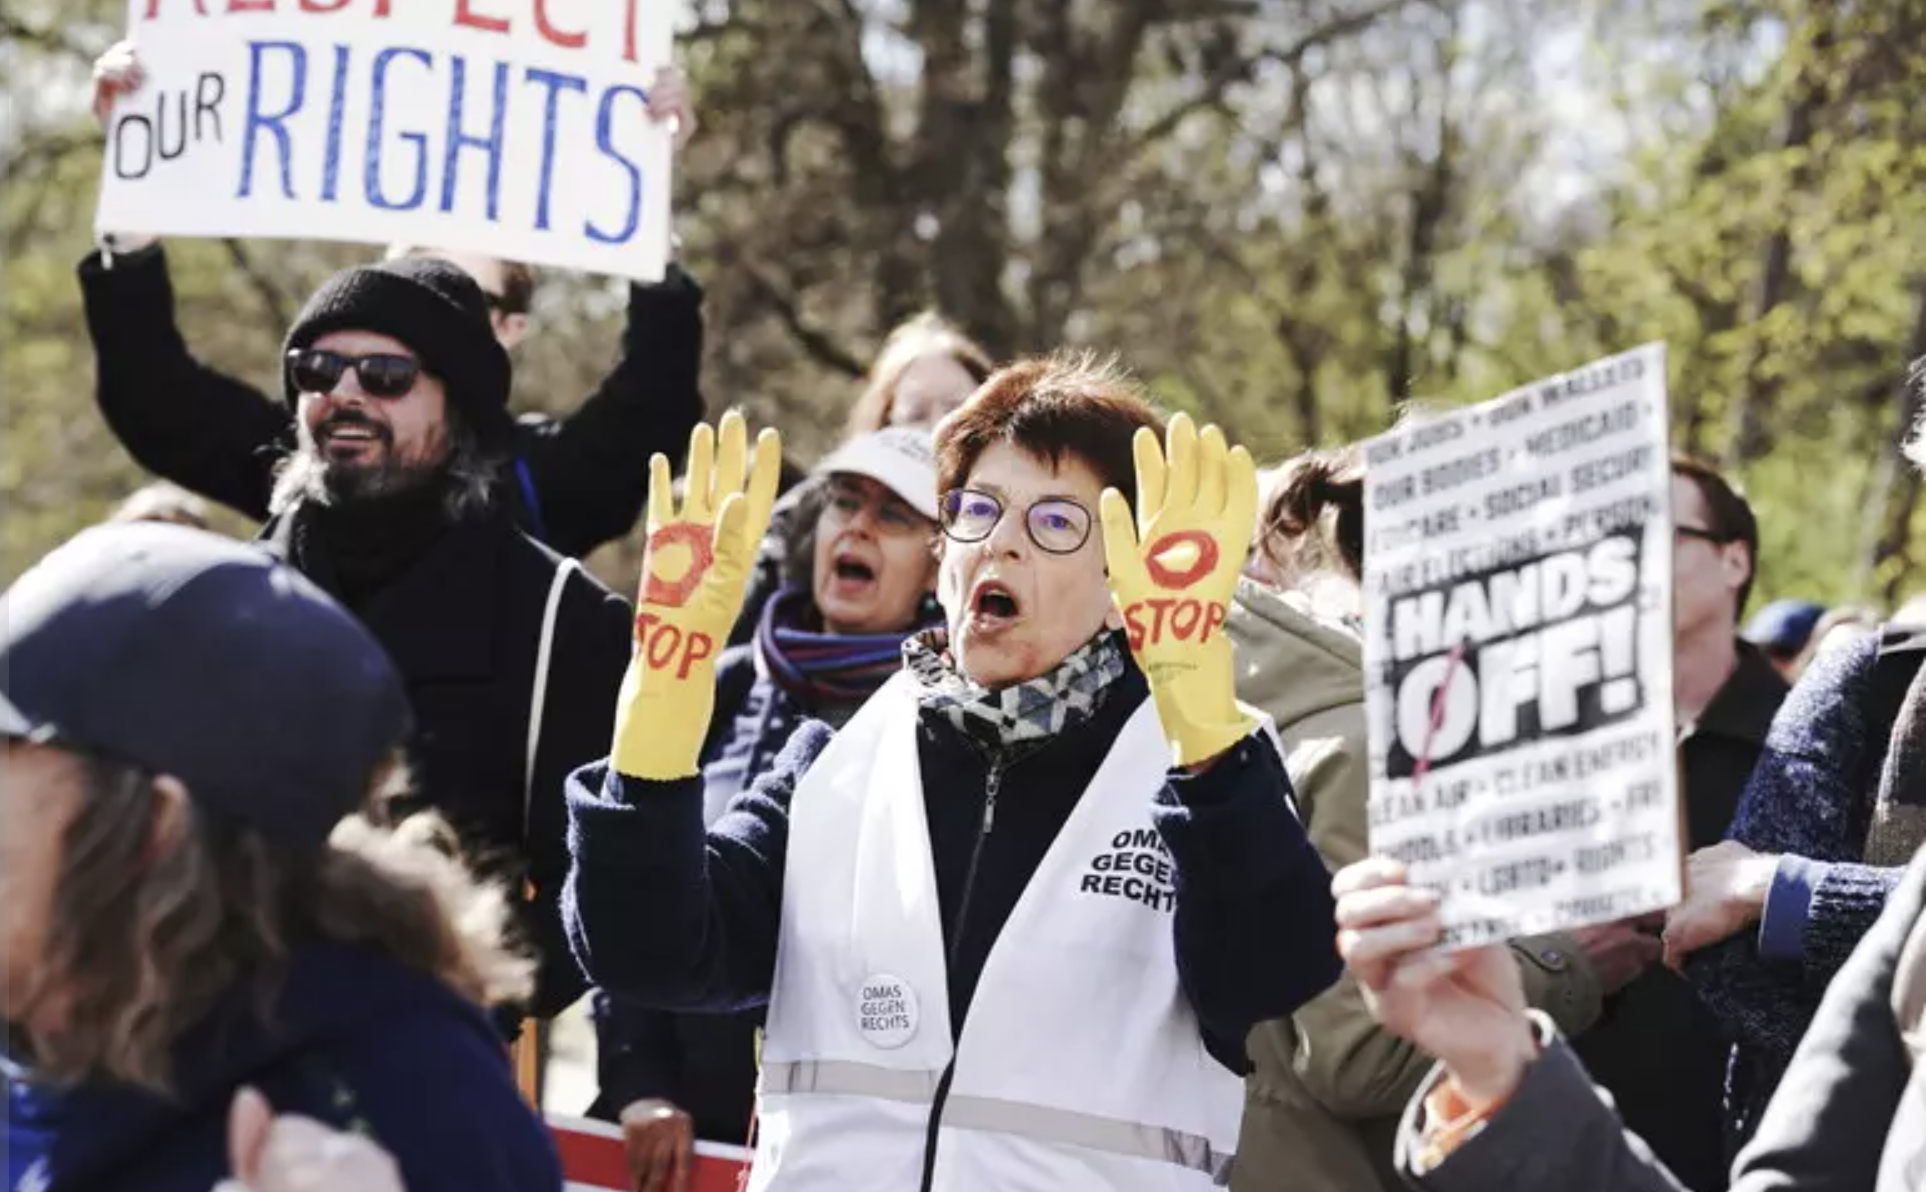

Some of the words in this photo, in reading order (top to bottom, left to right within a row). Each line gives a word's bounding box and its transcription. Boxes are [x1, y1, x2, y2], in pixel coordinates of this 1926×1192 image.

[114, 71, 226, 180] OUR
[235, 40, 651, 246] RIGHTS
[1373, 474, 1415, 511] OUR
[1421, 448, 1500, 494] BODIES
[1524, 399, 1638, 455] MEDICAID
[1485, 474, 1563, 521] SOCIAL
[1391, 534, 1638, 663] HANDS
[636, 612, 712, 680] TOP
[1123, 598, 1226, 652] STOP
[1397, 602, 1638, 762] OFF!
[1080, 874, 1176, 913] RECHT
[1091, 852, 1172, 885] GEGE
[860, 999, 905, 1016] GEGEN
[862, 984, 902, 1000] OMAS
[860, 1014, 910, 1031] RECHTS
